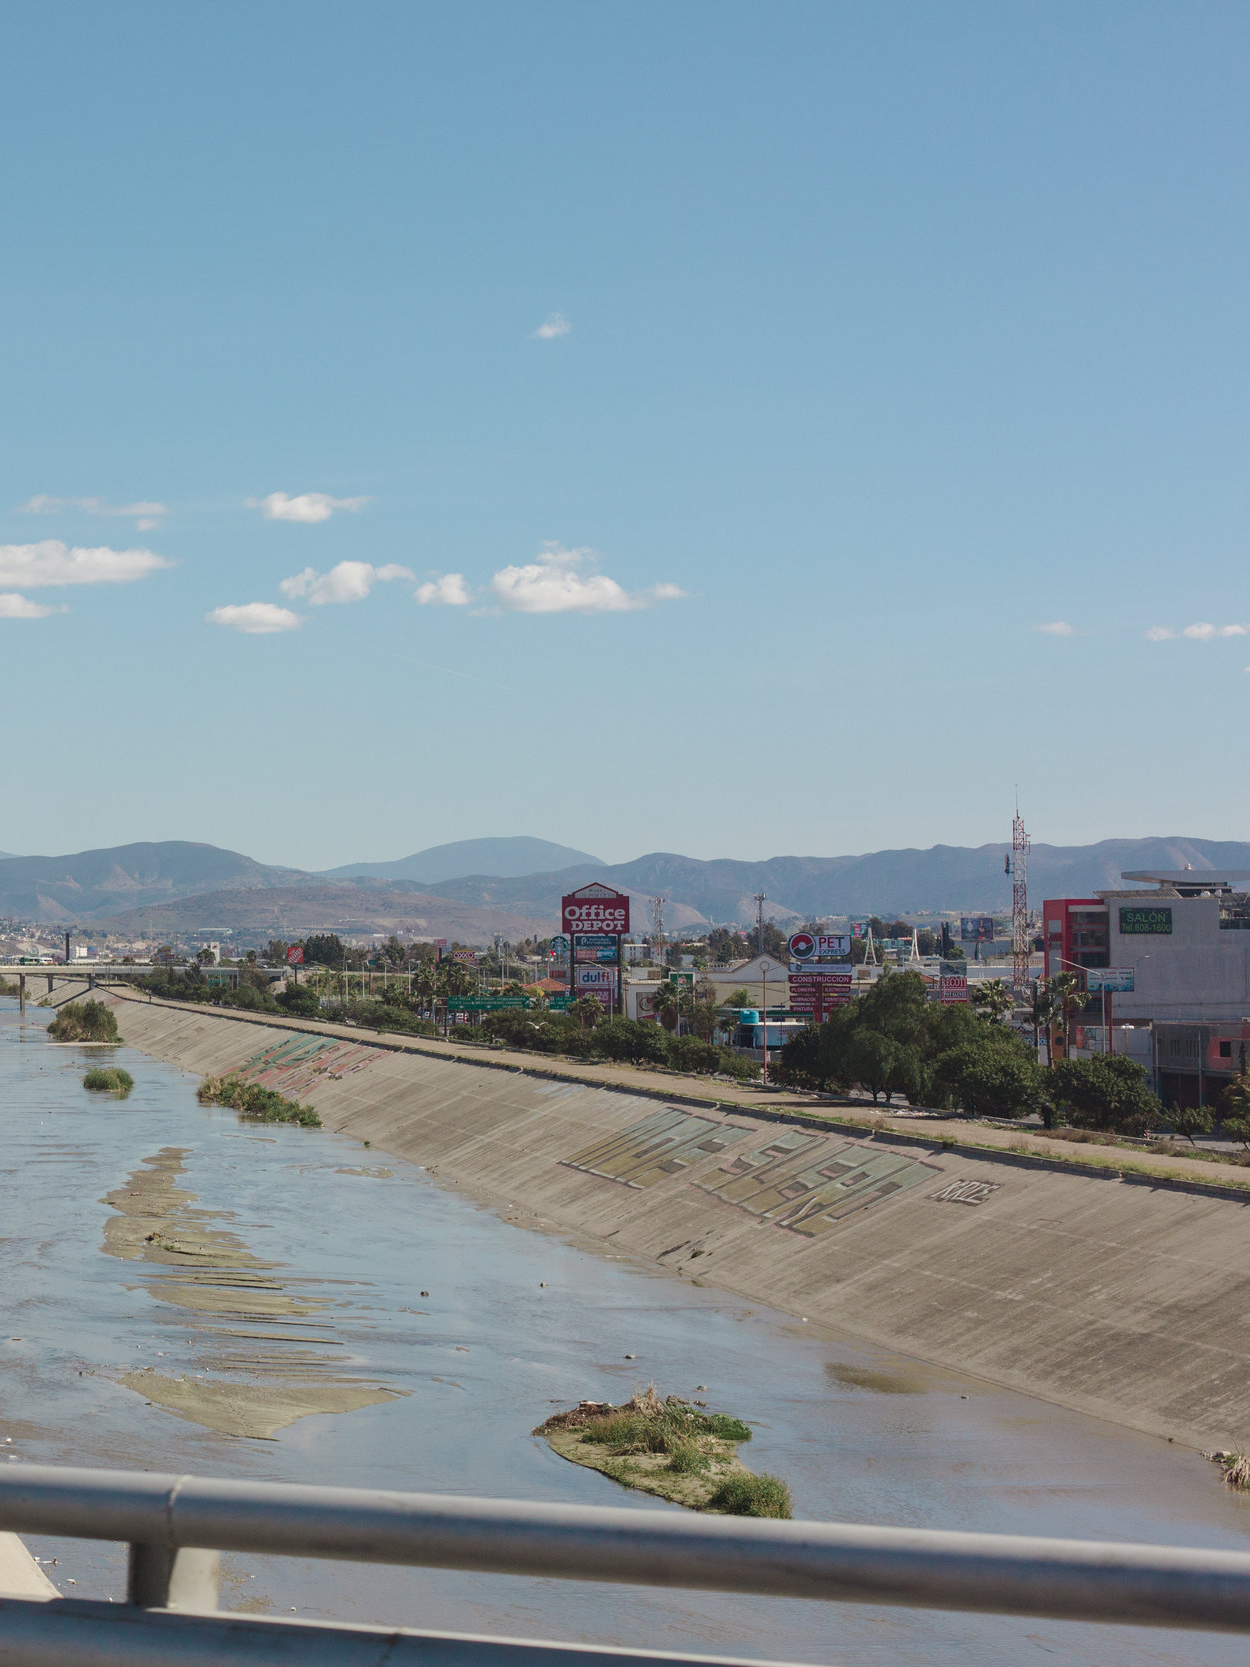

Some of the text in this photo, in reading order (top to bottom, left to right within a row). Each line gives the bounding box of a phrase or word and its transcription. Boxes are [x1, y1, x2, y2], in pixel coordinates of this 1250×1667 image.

[564, 905, 626, 920] Office
[1126, 912, 1166, 922] SALÓN
[571, 921, 625, 930] DEPOT
[818, 937, 845, 948] PET
[582, 971, 610, 983] dulfi
